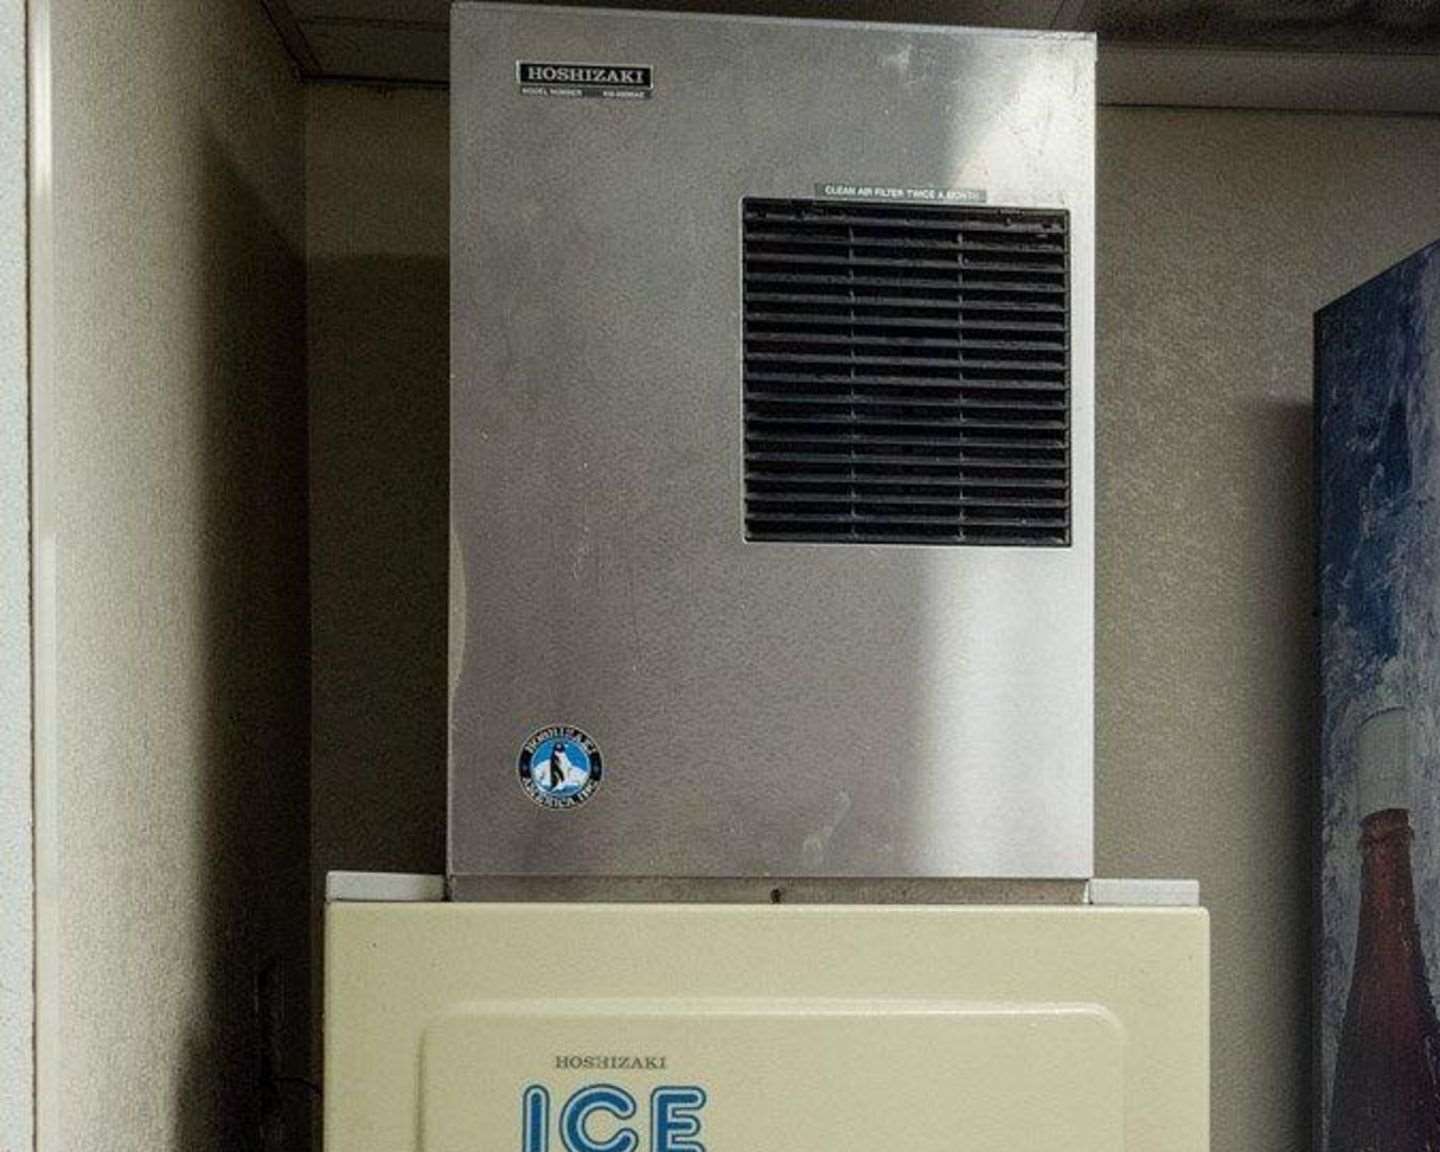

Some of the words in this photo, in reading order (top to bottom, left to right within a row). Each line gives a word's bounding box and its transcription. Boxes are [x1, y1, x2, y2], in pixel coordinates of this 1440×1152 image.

[528, 67, 644, 84] HOSHIZAKI
[825, 184, 857, 196] CLEAN
[858, 186, 873, 197] AIR
[874, 187, 904, 199] FILTER
[556, 1055, 667, 1070] HOSHIZAKI
